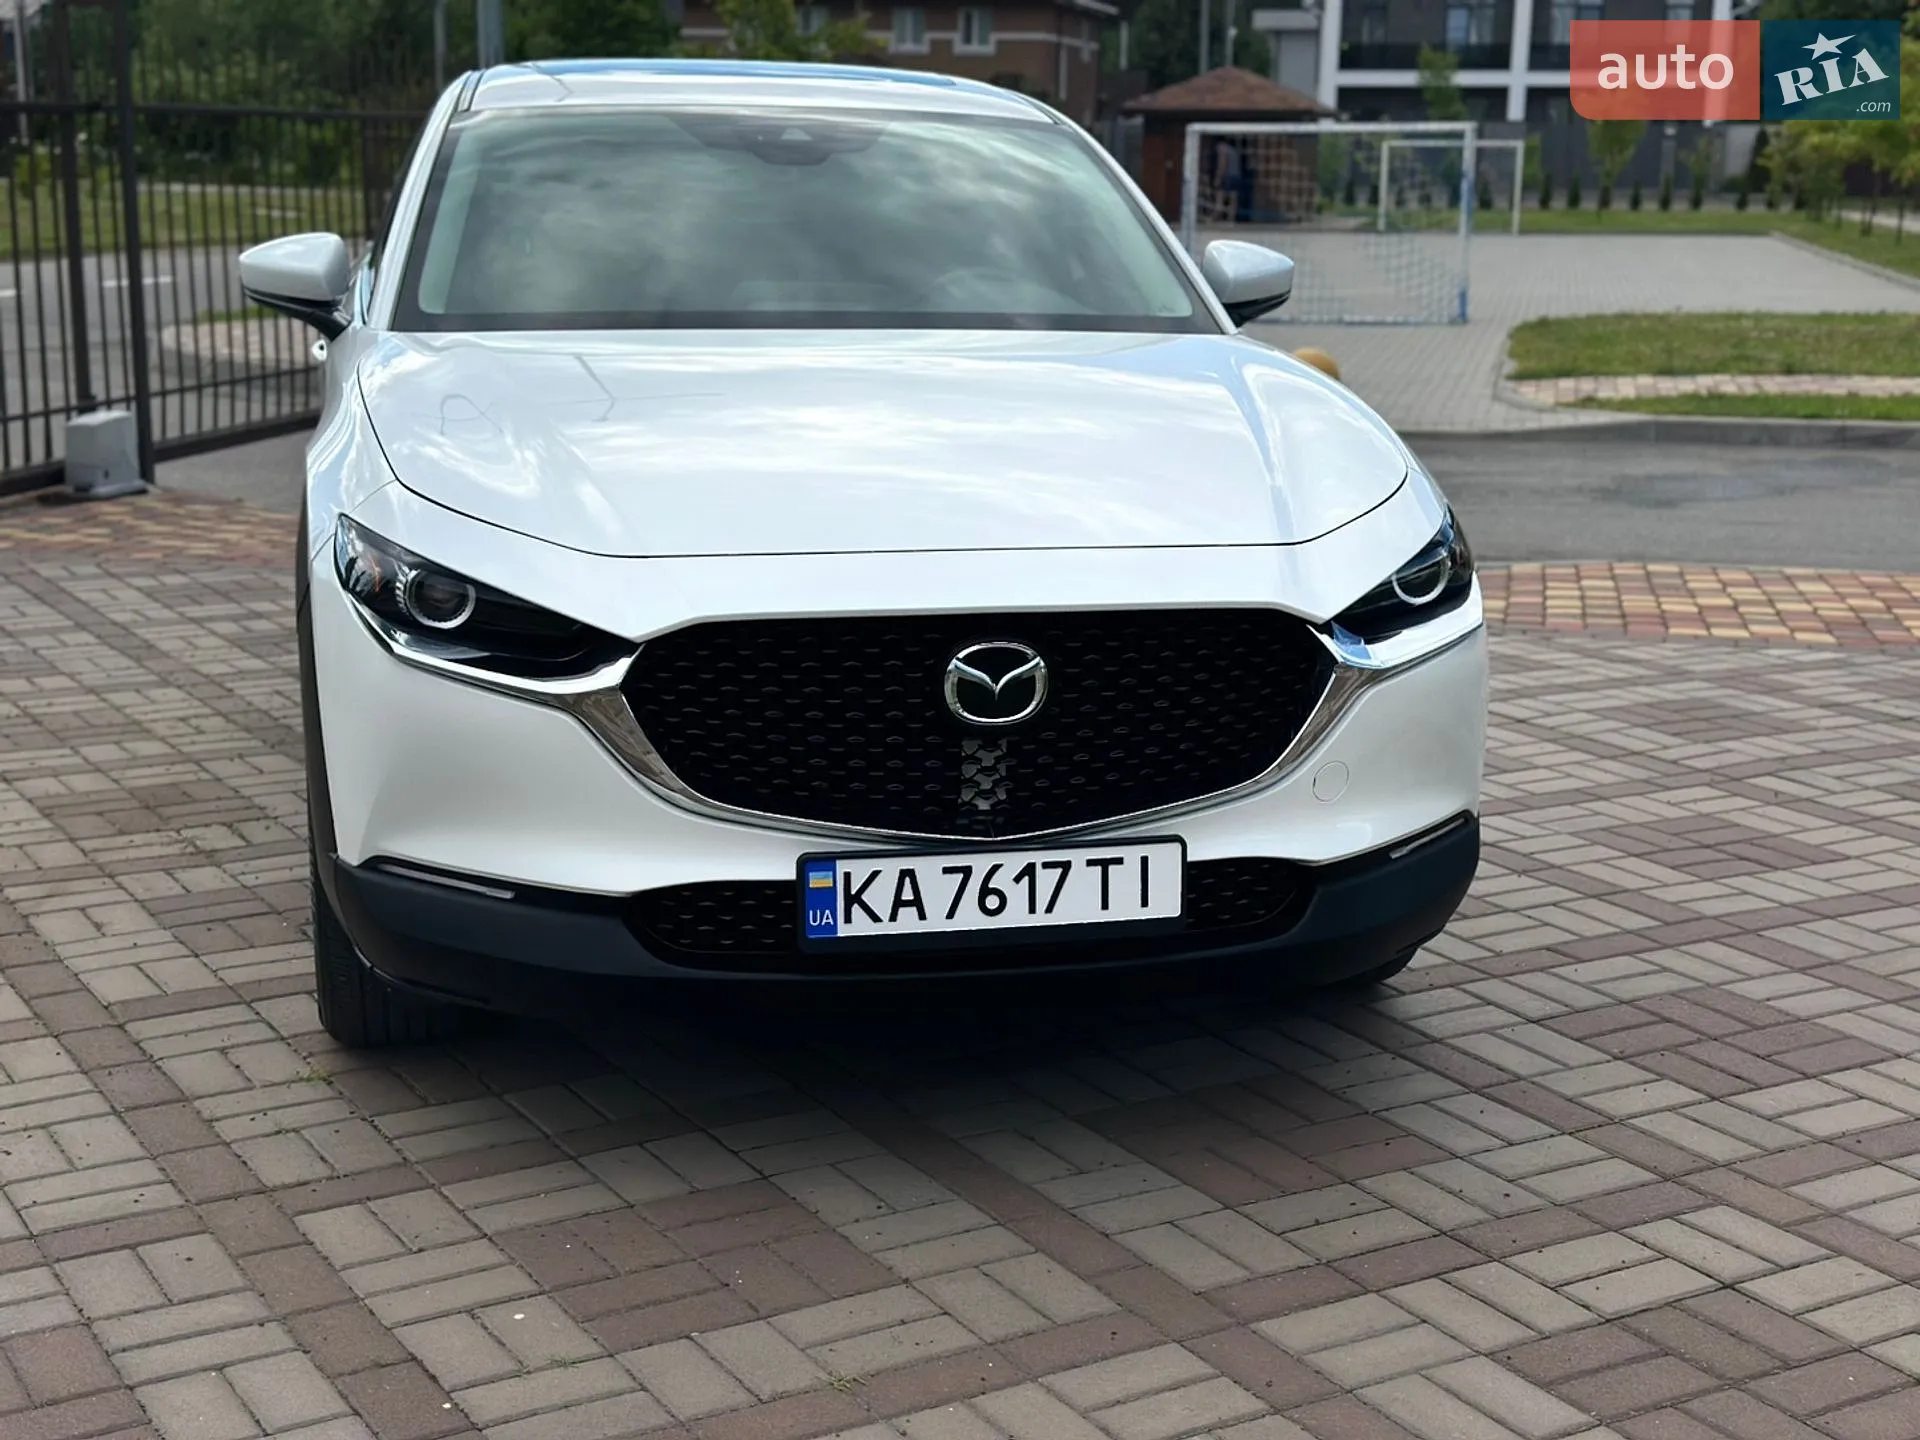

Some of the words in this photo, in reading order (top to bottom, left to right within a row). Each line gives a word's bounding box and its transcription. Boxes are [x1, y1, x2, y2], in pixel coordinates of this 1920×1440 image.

[843, 868, 928, 924] KA
[942, 860, 1072, 920] 7617
[1086, 855, 1149, 911] TI
[809, 909, 834, 926] UA
